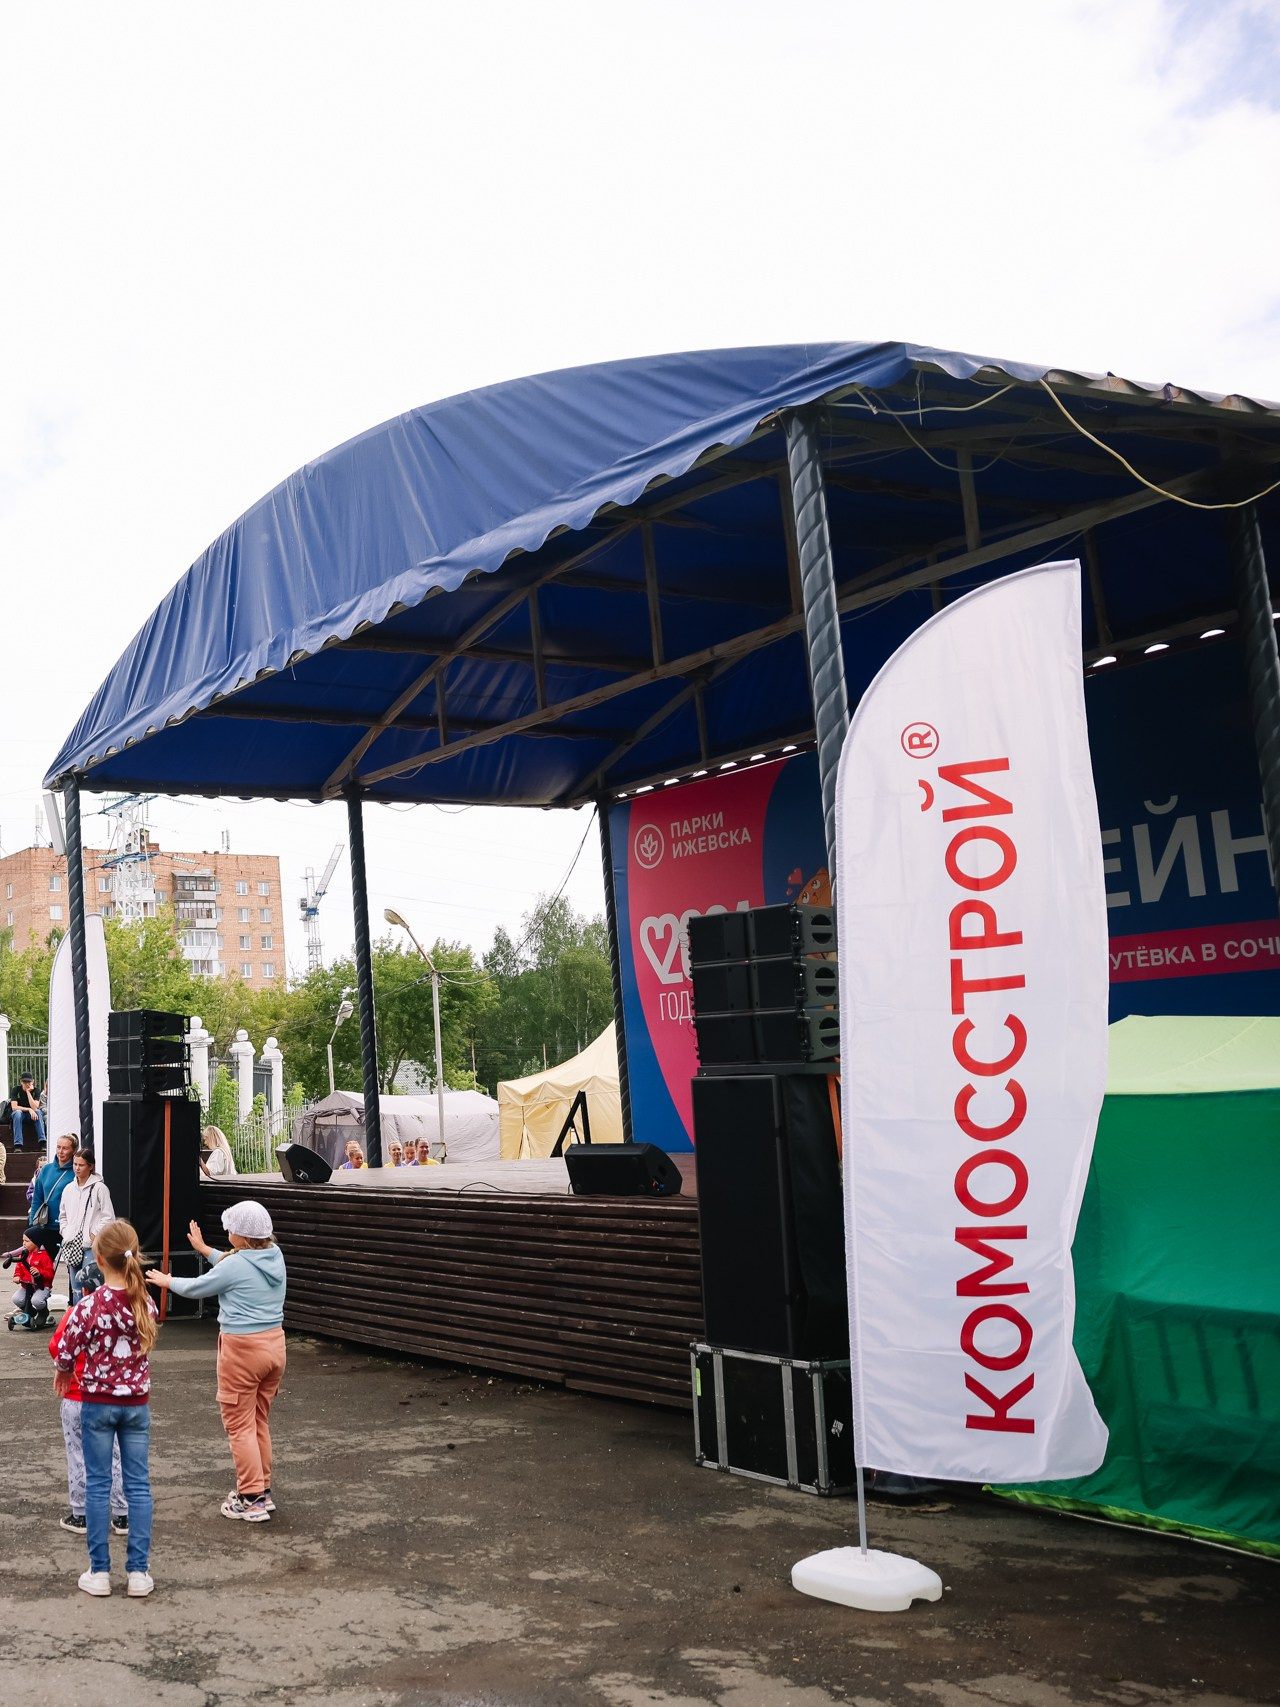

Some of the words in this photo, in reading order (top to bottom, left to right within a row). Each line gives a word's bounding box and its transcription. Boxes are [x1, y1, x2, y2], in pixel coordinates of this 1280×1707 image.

[670, 811, 724, 839] ПАРКИ
[672, 827, 752, 859] ИЖЕВСКА
[1201, 943, 1217, 962] В
